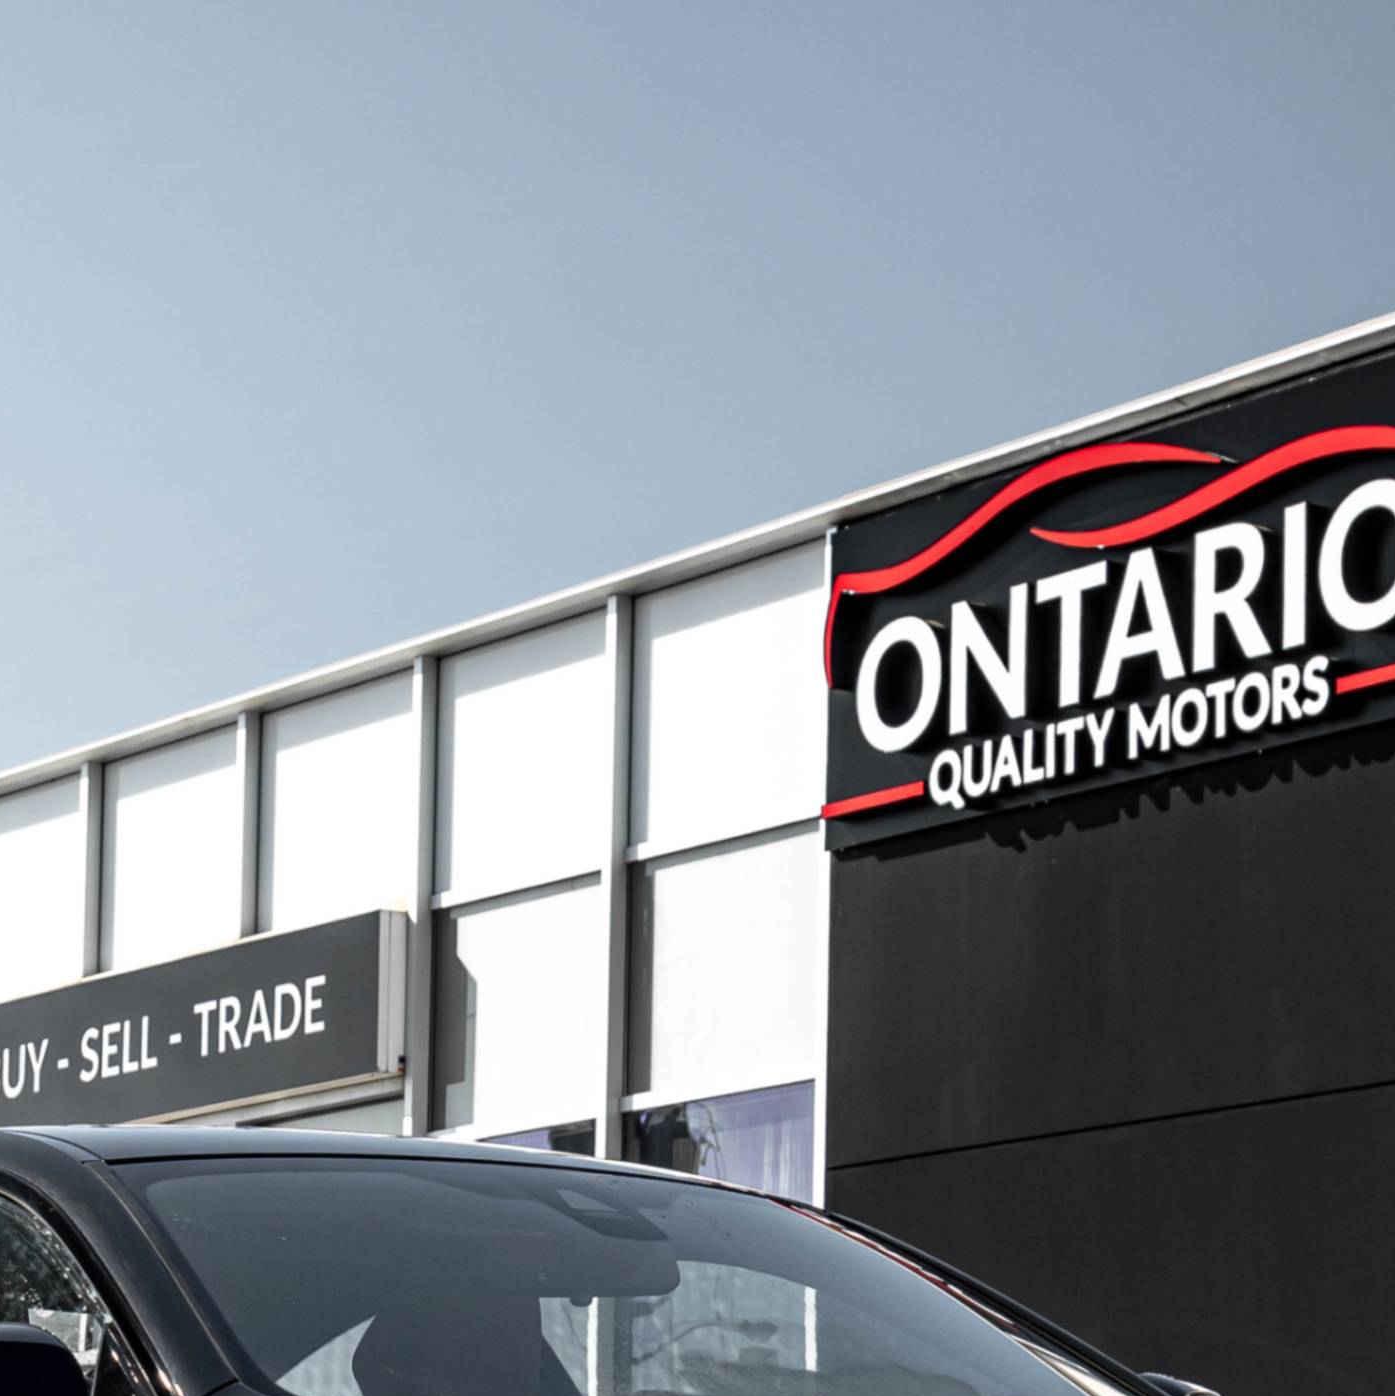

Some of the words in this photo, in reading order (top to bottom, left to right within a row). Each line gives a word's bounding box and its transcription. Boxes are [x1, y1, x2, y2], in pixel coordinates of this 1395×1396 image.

[927, 707, 1116, 810] QUALITY
[1127, 655, 1330, 760] MOTORS
[78, 1015, 159, 1083] SELL
[192, 974, 327, 1057] TRADE
